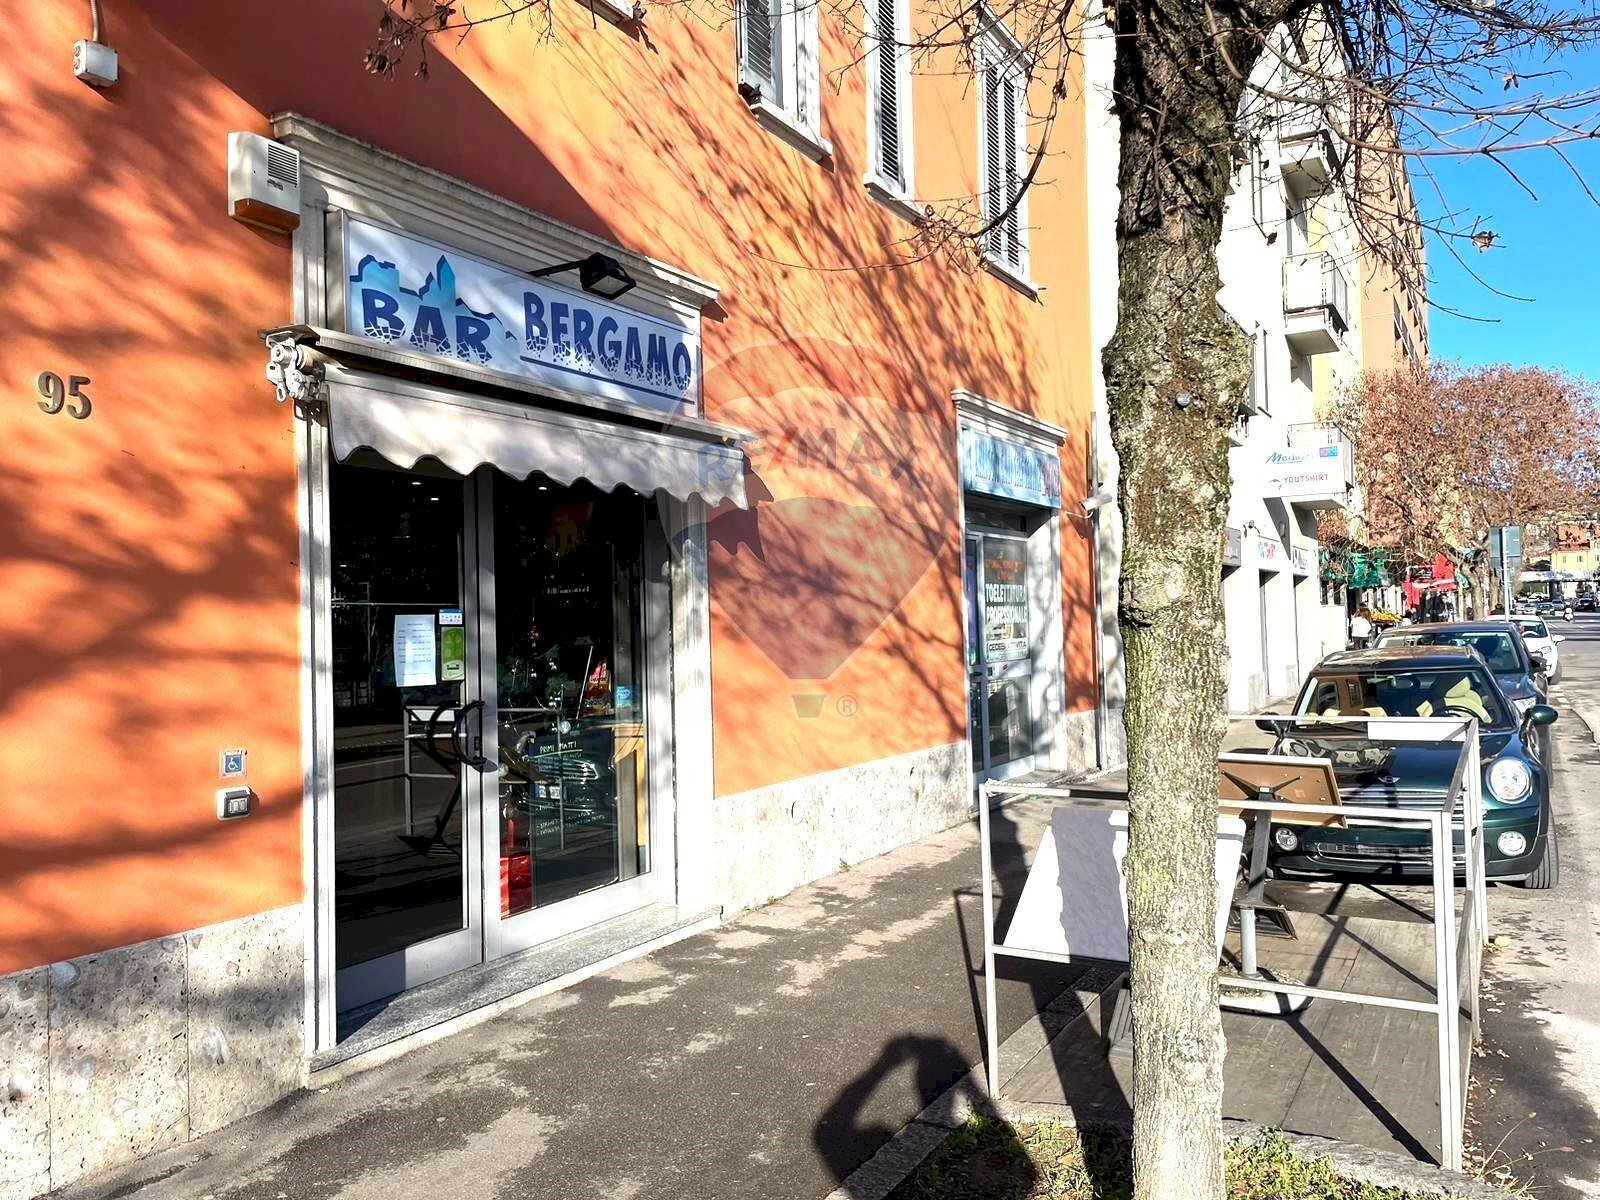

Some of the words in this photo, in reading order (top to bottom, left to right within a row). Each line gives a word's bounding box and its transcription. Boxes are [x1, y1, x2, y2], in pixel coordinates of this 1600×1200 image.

[362, 287, 493, 364] BAR
[523, 291, 692, 391] BERGAMO
[37, 371, 92, 420] 95
[1284, 473, 1328, 483] YOUTSHIRT
[986, 605, 1028, 625] PROFESSIONALE
[539, 744, 555, 754] PRIMI
